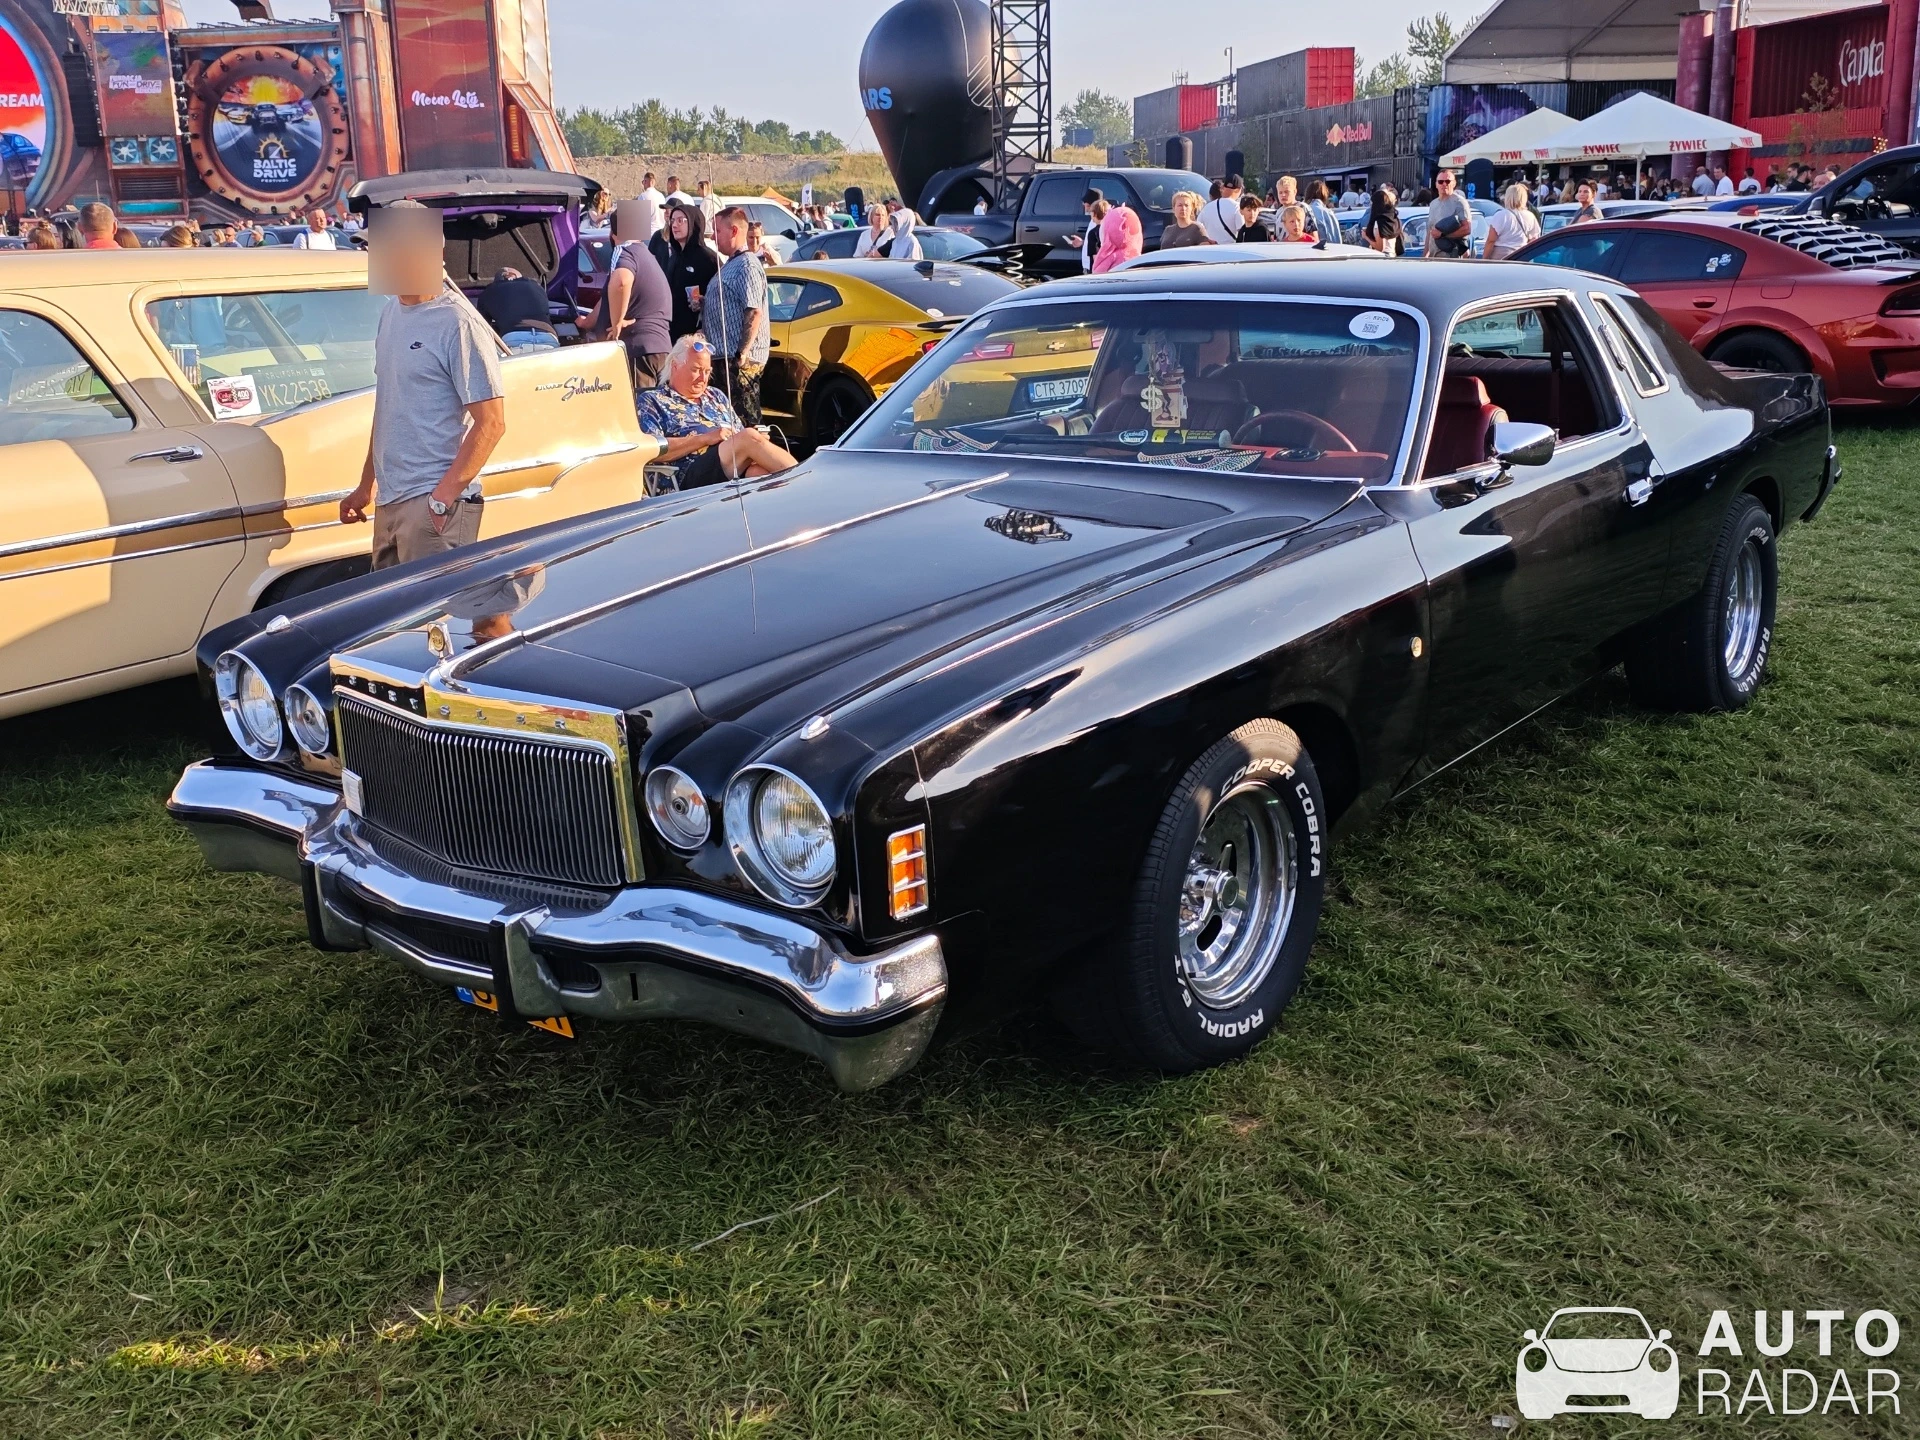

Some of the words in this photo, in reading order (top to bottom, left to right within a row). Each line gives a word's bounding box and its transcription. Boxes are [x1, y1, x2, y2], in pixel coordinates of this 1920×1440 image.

[1582, 143, 1621, 154] ŻYWIEC
[253, 158, 297, 169] BALTIC
[253, 168, 297, 178] DRIVE
[258, 379, 332, 406] YK22538
[1034, 382, 1057, 398] CTR
[1746, 626, 1770, 686] RADIAL
[1220, 758, 1296, 797] COOPER
[1295, 782, 1321, 877] COBRA
[1197, 1007, 1265, 1038] RADIAL
